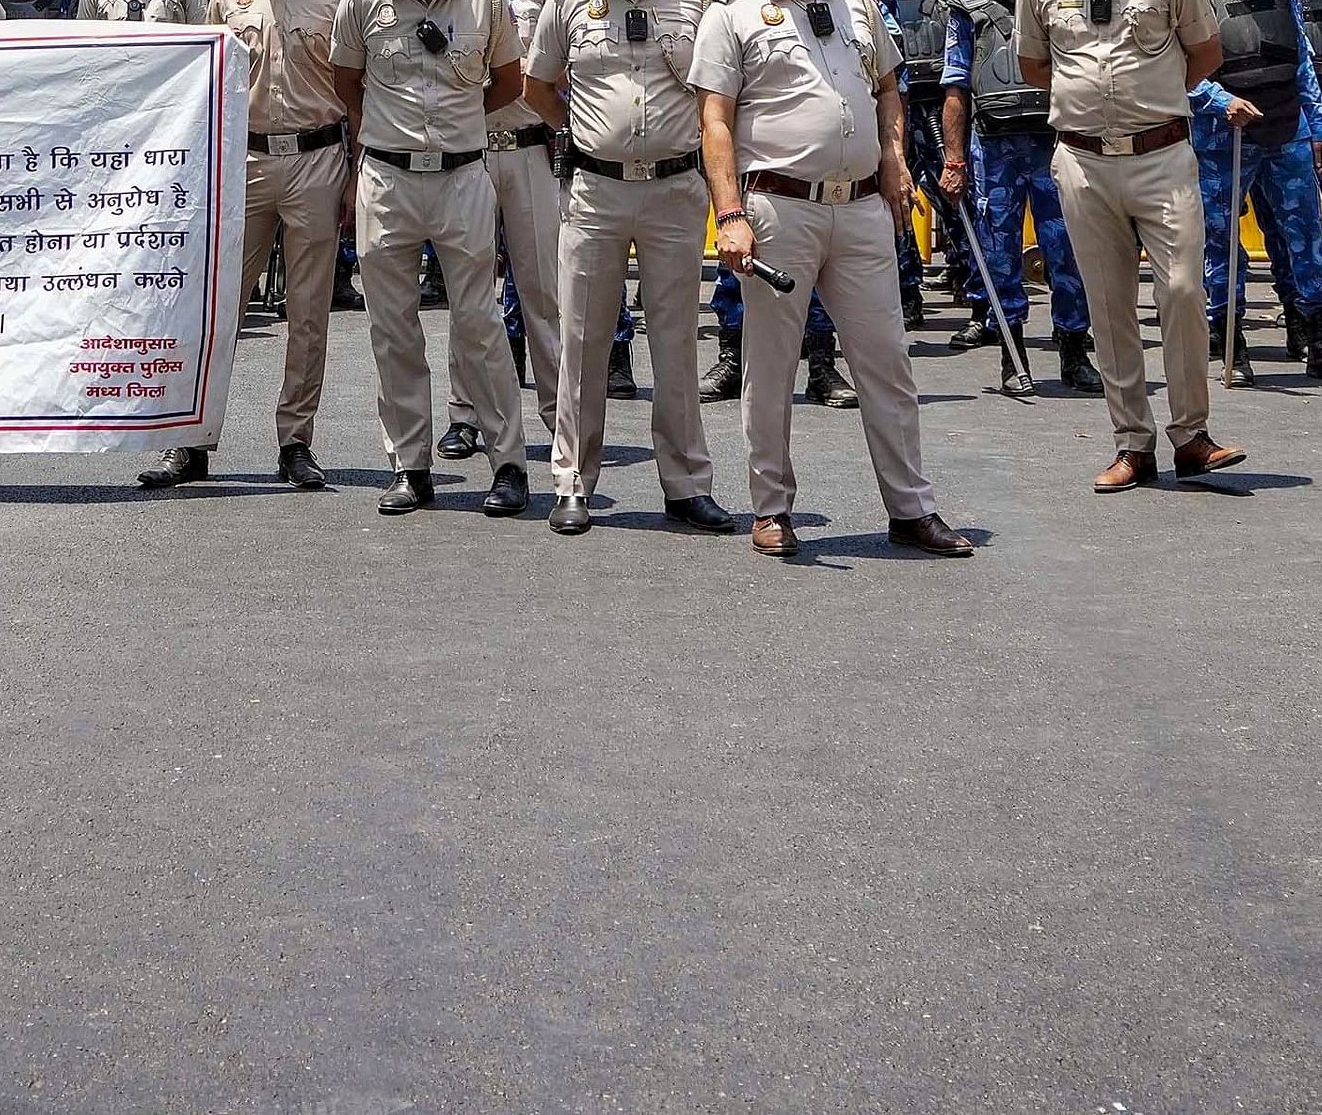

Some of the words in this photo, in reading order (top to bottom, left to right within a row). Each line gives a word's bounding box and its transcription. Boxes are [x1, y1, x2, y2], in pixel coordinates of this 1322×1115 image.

[22, 146, 40, 172] है
[50, 146, 80, 169] कि
[90, 143, 133, 170] यहां
[144, 148, 191, 166] धारा
[53, 187, 77, 211] से
[87, 186, 164, 216] अनुरोध
[170, 182, 190, 209] है
[24, 229, 76, 254] होना
[81, 233, 111, 249] या
[133, 266, 189, 290] करने
[80, 335, 178, 355] आदेशानुसार
[69, 362, 136, 379] उपायुक्त
[140, 358, 184, 379] पुलिस
[86, 386, 122, 398] मध्य
[125, 382, 166, 398] जिला
